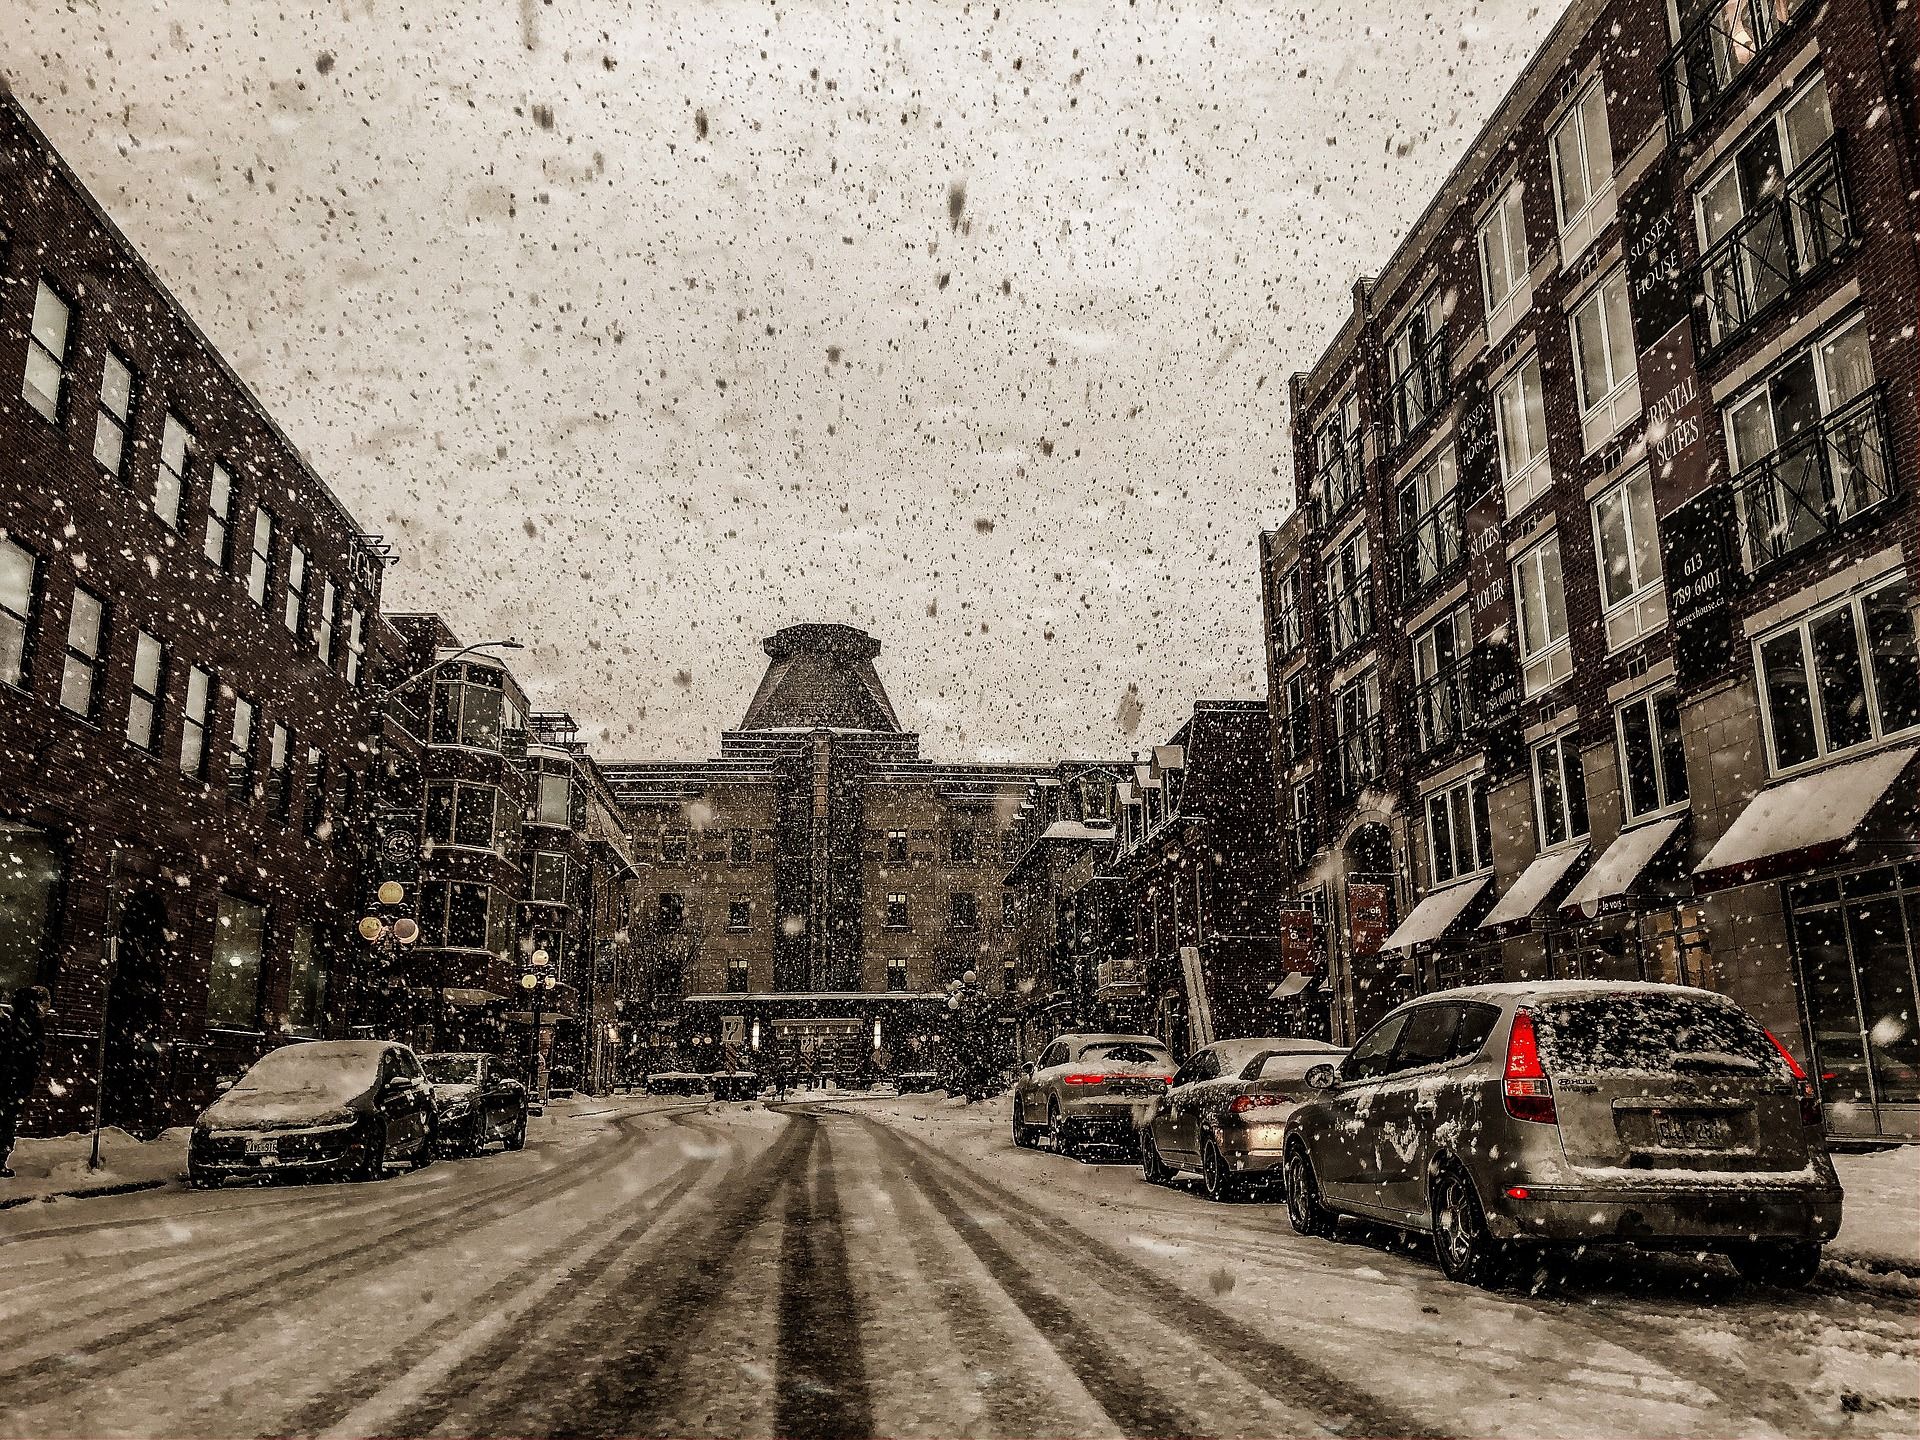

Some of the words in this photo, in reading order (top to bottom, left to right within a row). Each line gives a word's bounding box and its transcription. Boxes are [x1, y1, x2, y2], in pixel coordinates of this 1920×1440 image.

[1630, 216, 1673, 264] SUSSEX
[1636, 249, 1678, 300] HOUSE
[1649, 376, 1697, 423] RENTAL
[1460, 403, 1486, 436] SUSSEX
[1463, 431, 1488, 466] HOUSE
[1656, 416, 1699, 467] SUITES
[1470, 522, 1500, 560] SUITES
[1684, 553, 1703, 577] 613
[1476, 578, 1505, 613] LOUER
[1675, 597, 1725, 629] sussexhouse.ca
[1492, 672, 1505, 690] 613
